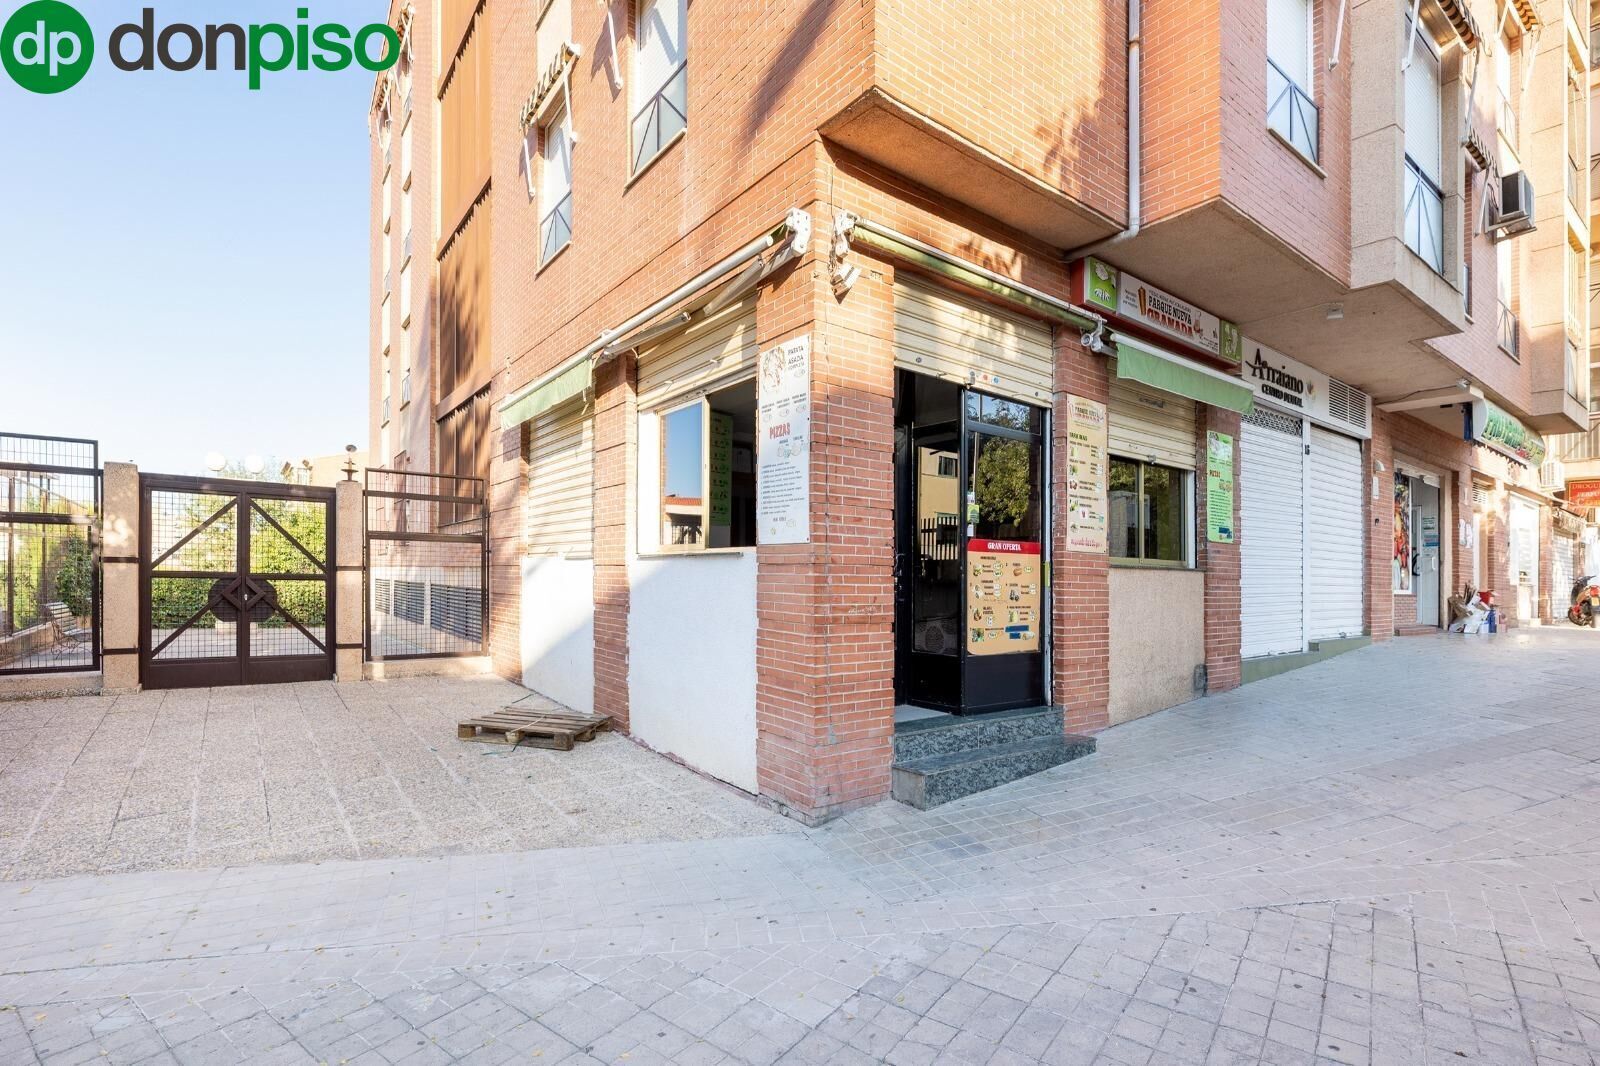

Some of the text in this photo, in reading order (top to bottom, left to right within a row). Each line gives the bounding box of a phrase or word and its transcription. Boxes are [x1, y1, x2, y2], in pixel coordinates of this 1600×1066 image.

[1148, 295, 1173, 316] PARQUE
[1173, 307, 1192, 324] NUEVA
[769, 422, 791, 440] PIZZAS
[987, 542, 1022, 551] GRAN OFERTA
